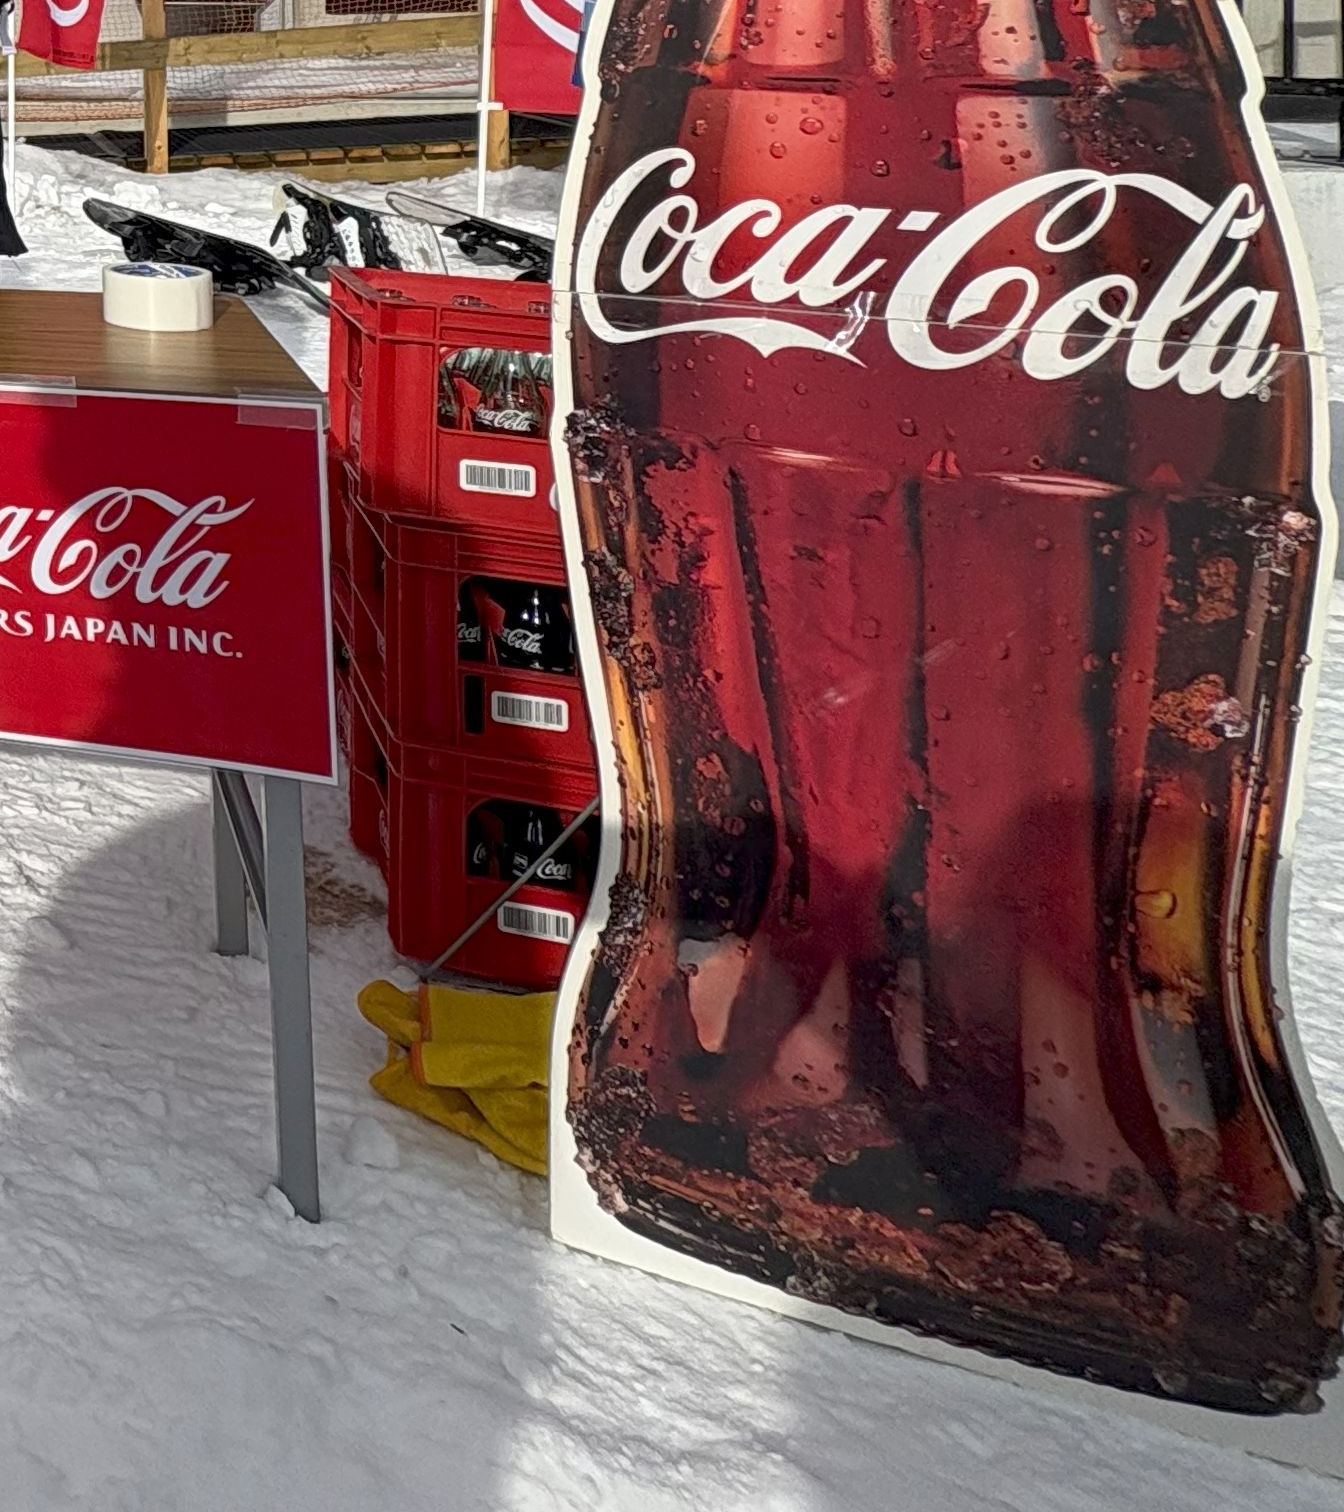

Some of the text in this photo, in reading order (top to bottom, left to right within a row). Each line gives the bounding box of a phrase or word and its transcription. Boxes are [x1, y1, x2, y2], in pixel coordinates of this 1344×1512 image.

[575, 147, 1281, 399] Coca-Cola
[44, 612, 156, 649] JAPAN
[168, 625, 244, 659] INC.
